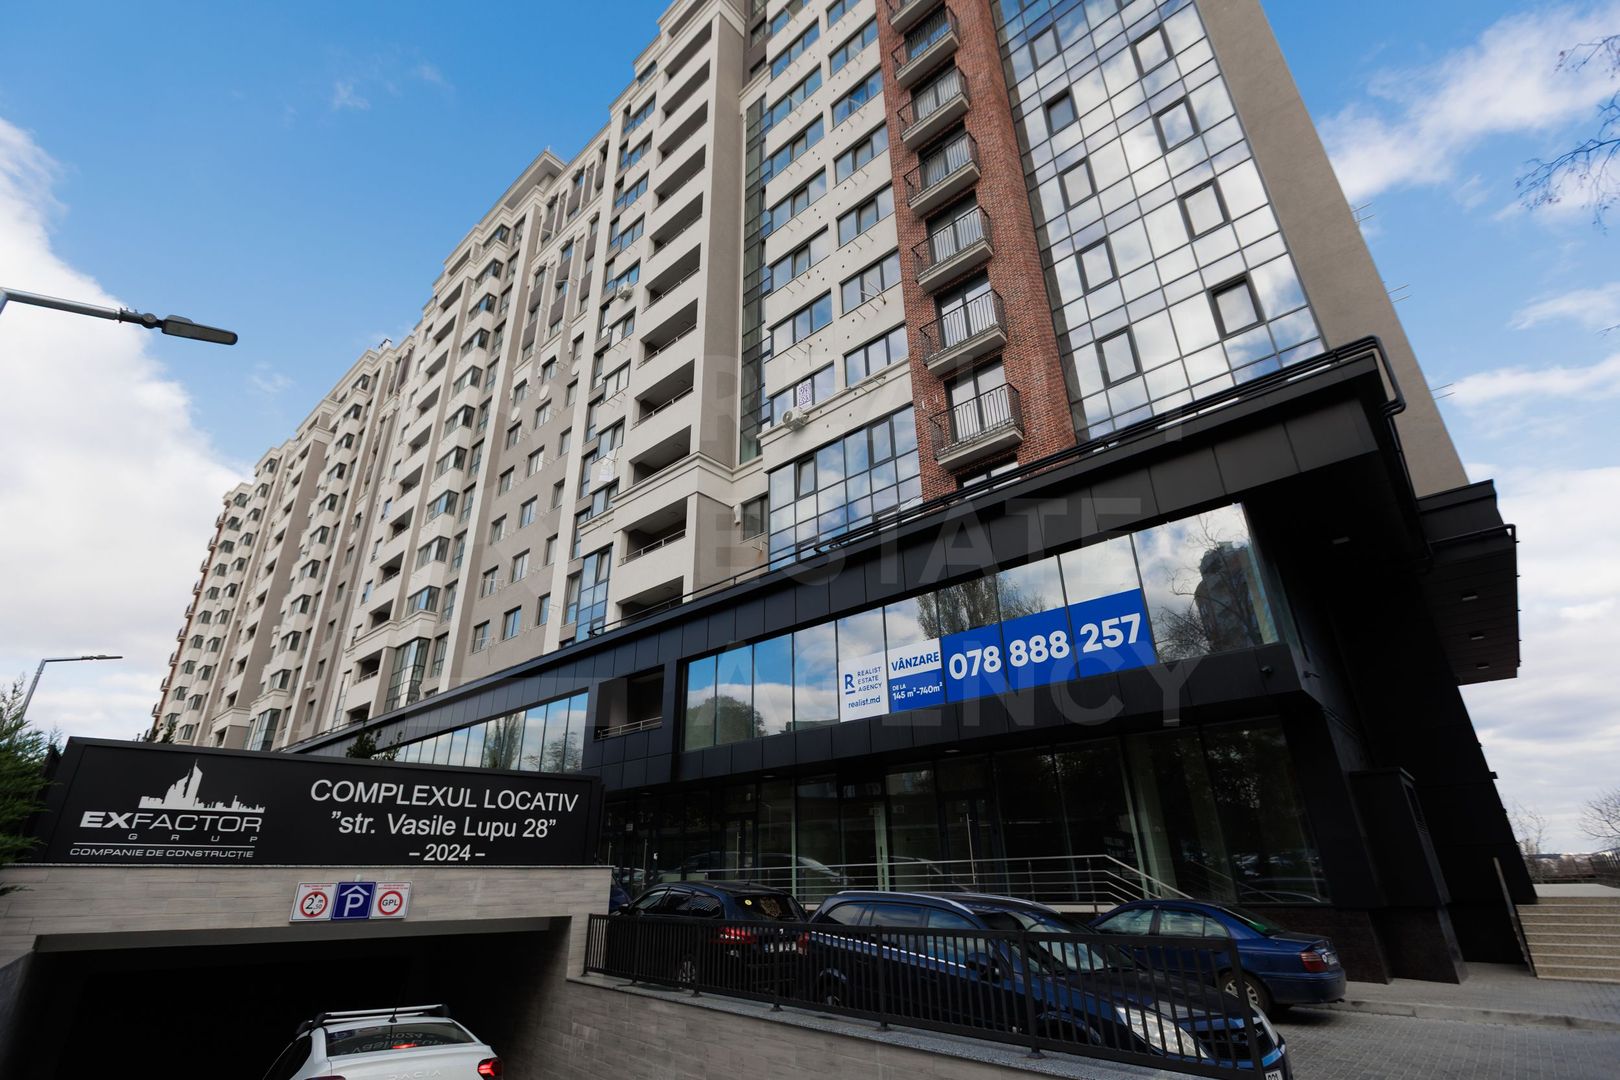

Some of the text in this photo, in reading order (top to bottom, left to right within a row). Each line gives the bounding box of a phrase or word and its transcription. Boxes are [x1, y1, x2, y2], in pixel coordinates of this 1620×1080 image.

[948, 612, 1141, 680] 078 888 257
[891, 651, 940, 671] VÂNZARE
[857, 666, 882, 677] REALIST
[844, 673, 855, 689] R
[858, 675, 879, 685] ESTATE
[858, 682, 882, 692] AGENCY
[848, 695, 881, 708] realist.md
[893, 691, 906, 700] 145
[310, 779, 579, 812] COMPLEXUL LOCATIV
[80, 811, 262, 832] EXFACTOR
[387, 813, 457, 836] Vasile
[463, 816, 516, 841] Lupu
[70, 847, 144, 857] COMPANIE
[146, 849, 164, 857] DE
[343, 893, 364, 916] P
[382, 899, 399, 907] GPL
